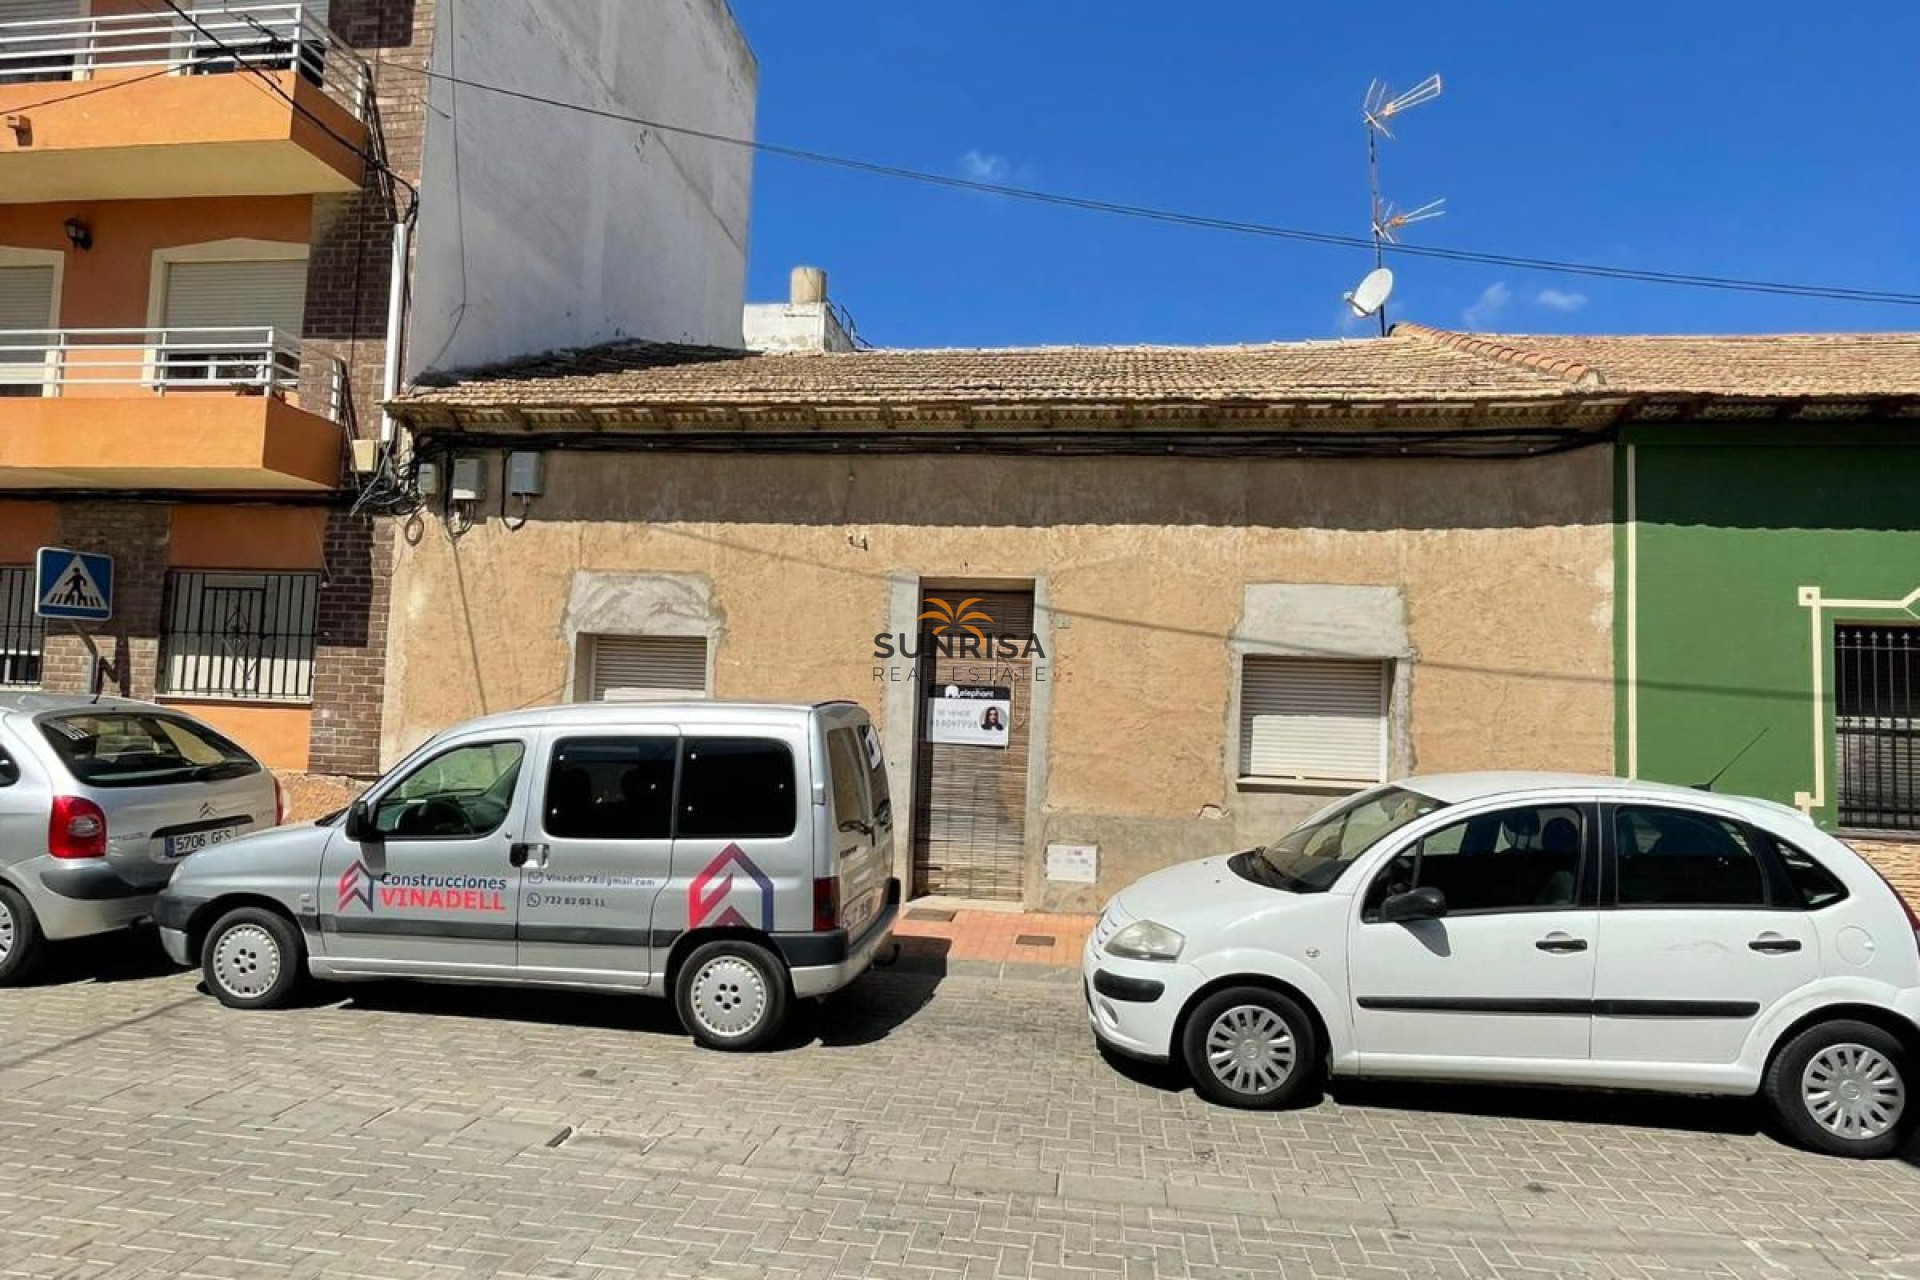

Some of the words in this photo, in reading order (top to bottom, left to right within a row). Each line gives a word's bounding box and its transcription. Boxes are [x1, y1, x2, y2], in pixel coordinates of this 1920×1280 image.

[175, 832, 206, 851] 5706
[382, 872, 507, 890] Construcciones
[379, 887, 507, 911] VINADELL
